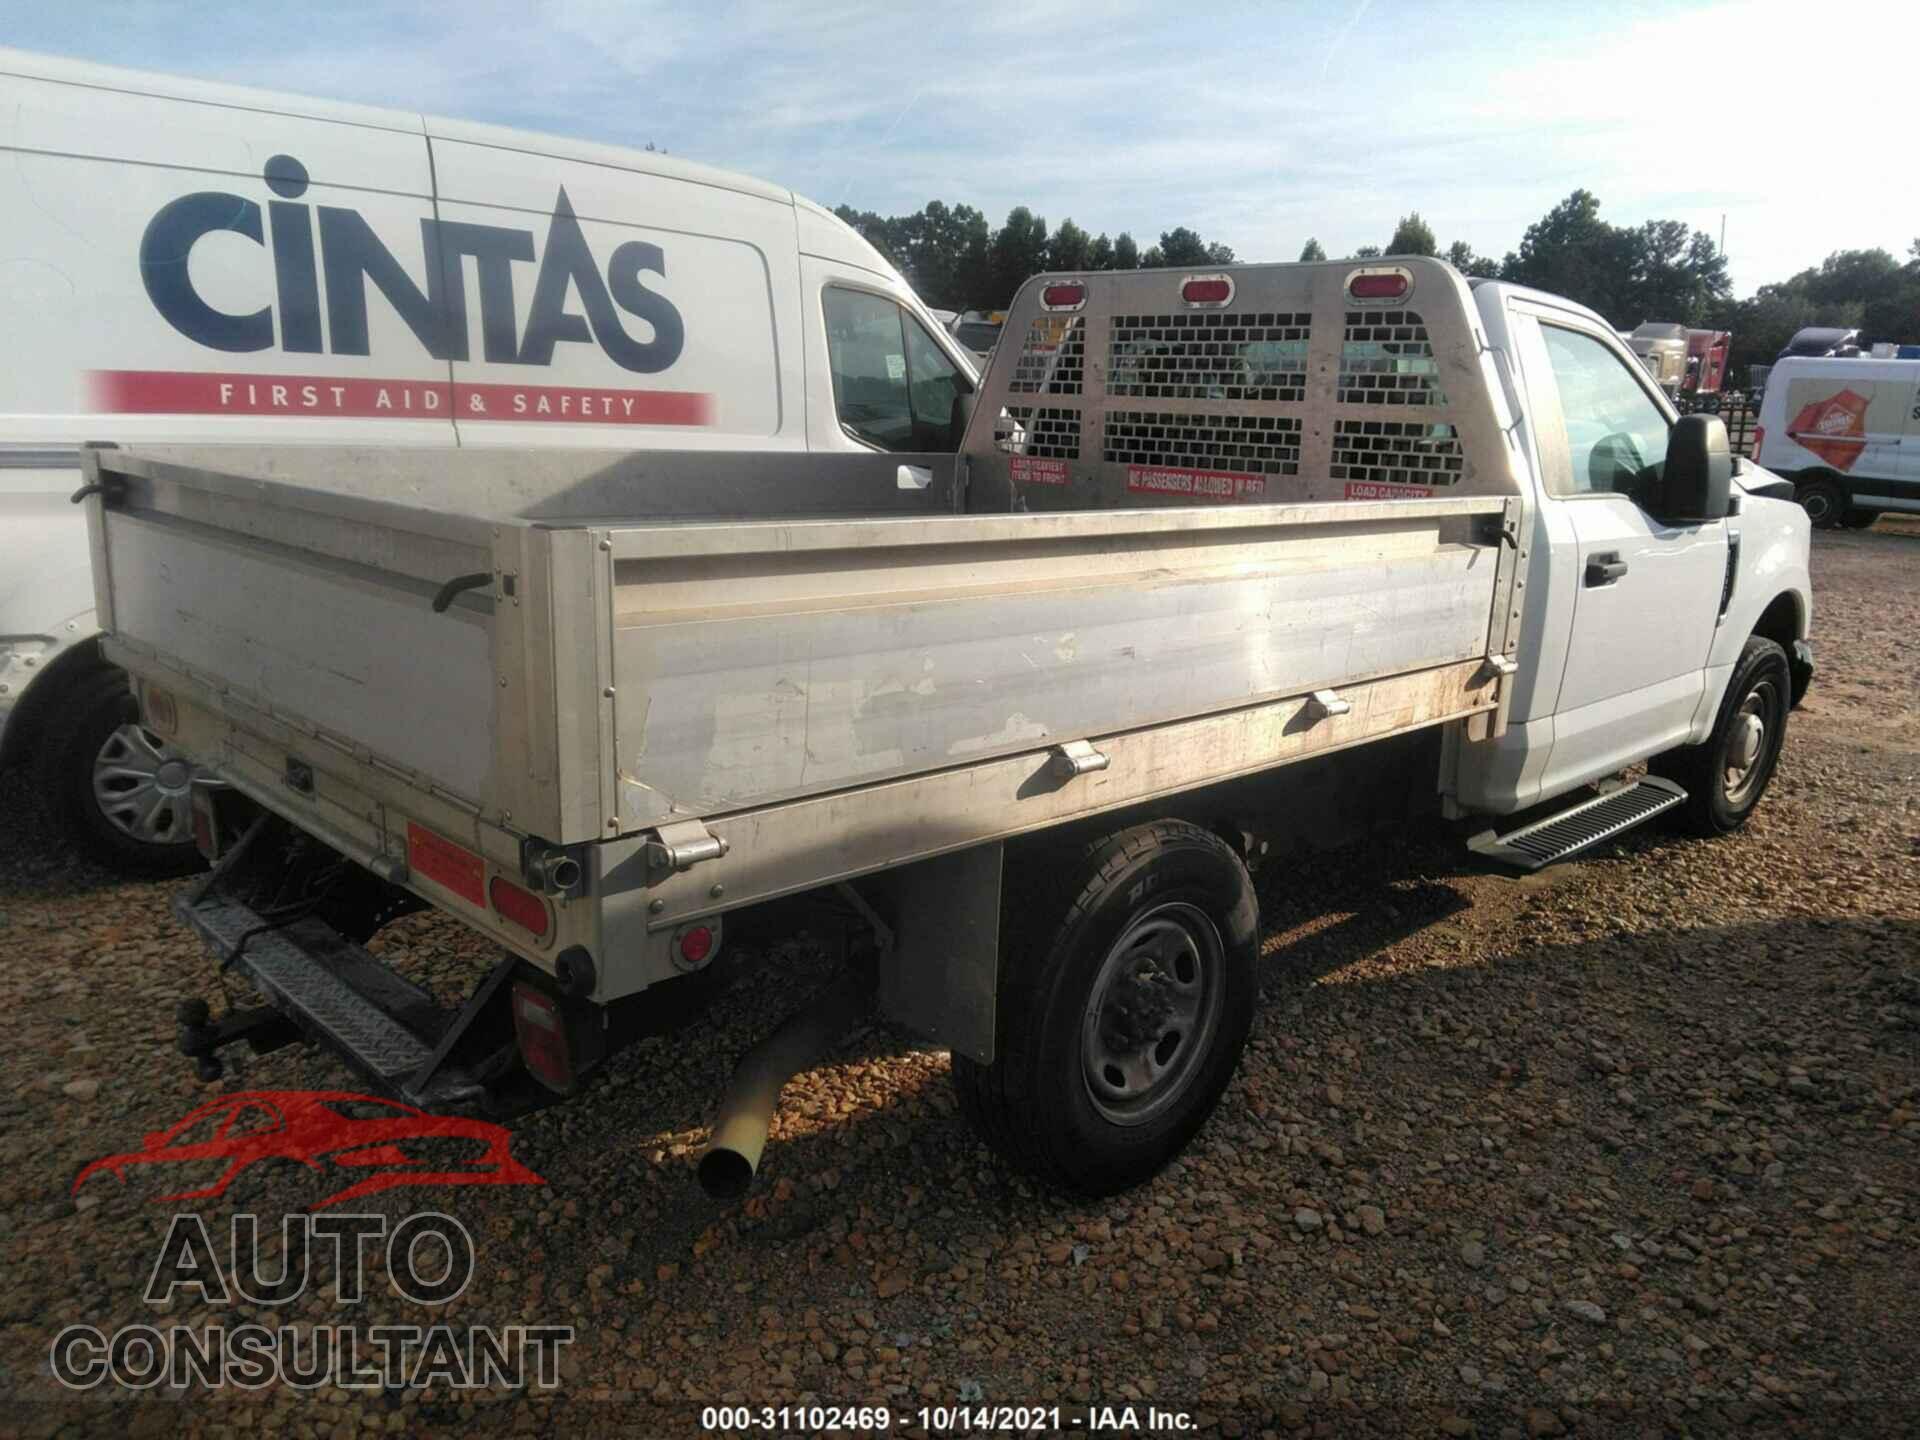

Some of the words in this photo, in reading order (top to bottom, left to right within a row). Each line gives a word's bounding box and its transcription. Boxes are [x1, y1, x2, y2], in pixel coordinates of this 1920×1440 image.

[139, 154, 684, 374] CINTAS
[220, 383, 345, 408] FIRST
[375, 388, 439, 411] AID
[470, 392, 486, 412] &
[513, 392, 637, 417] SAFETY
[1193, 474, 1234, 495] ALLOWED
[1351, 483, 1377, 497] LOAD
